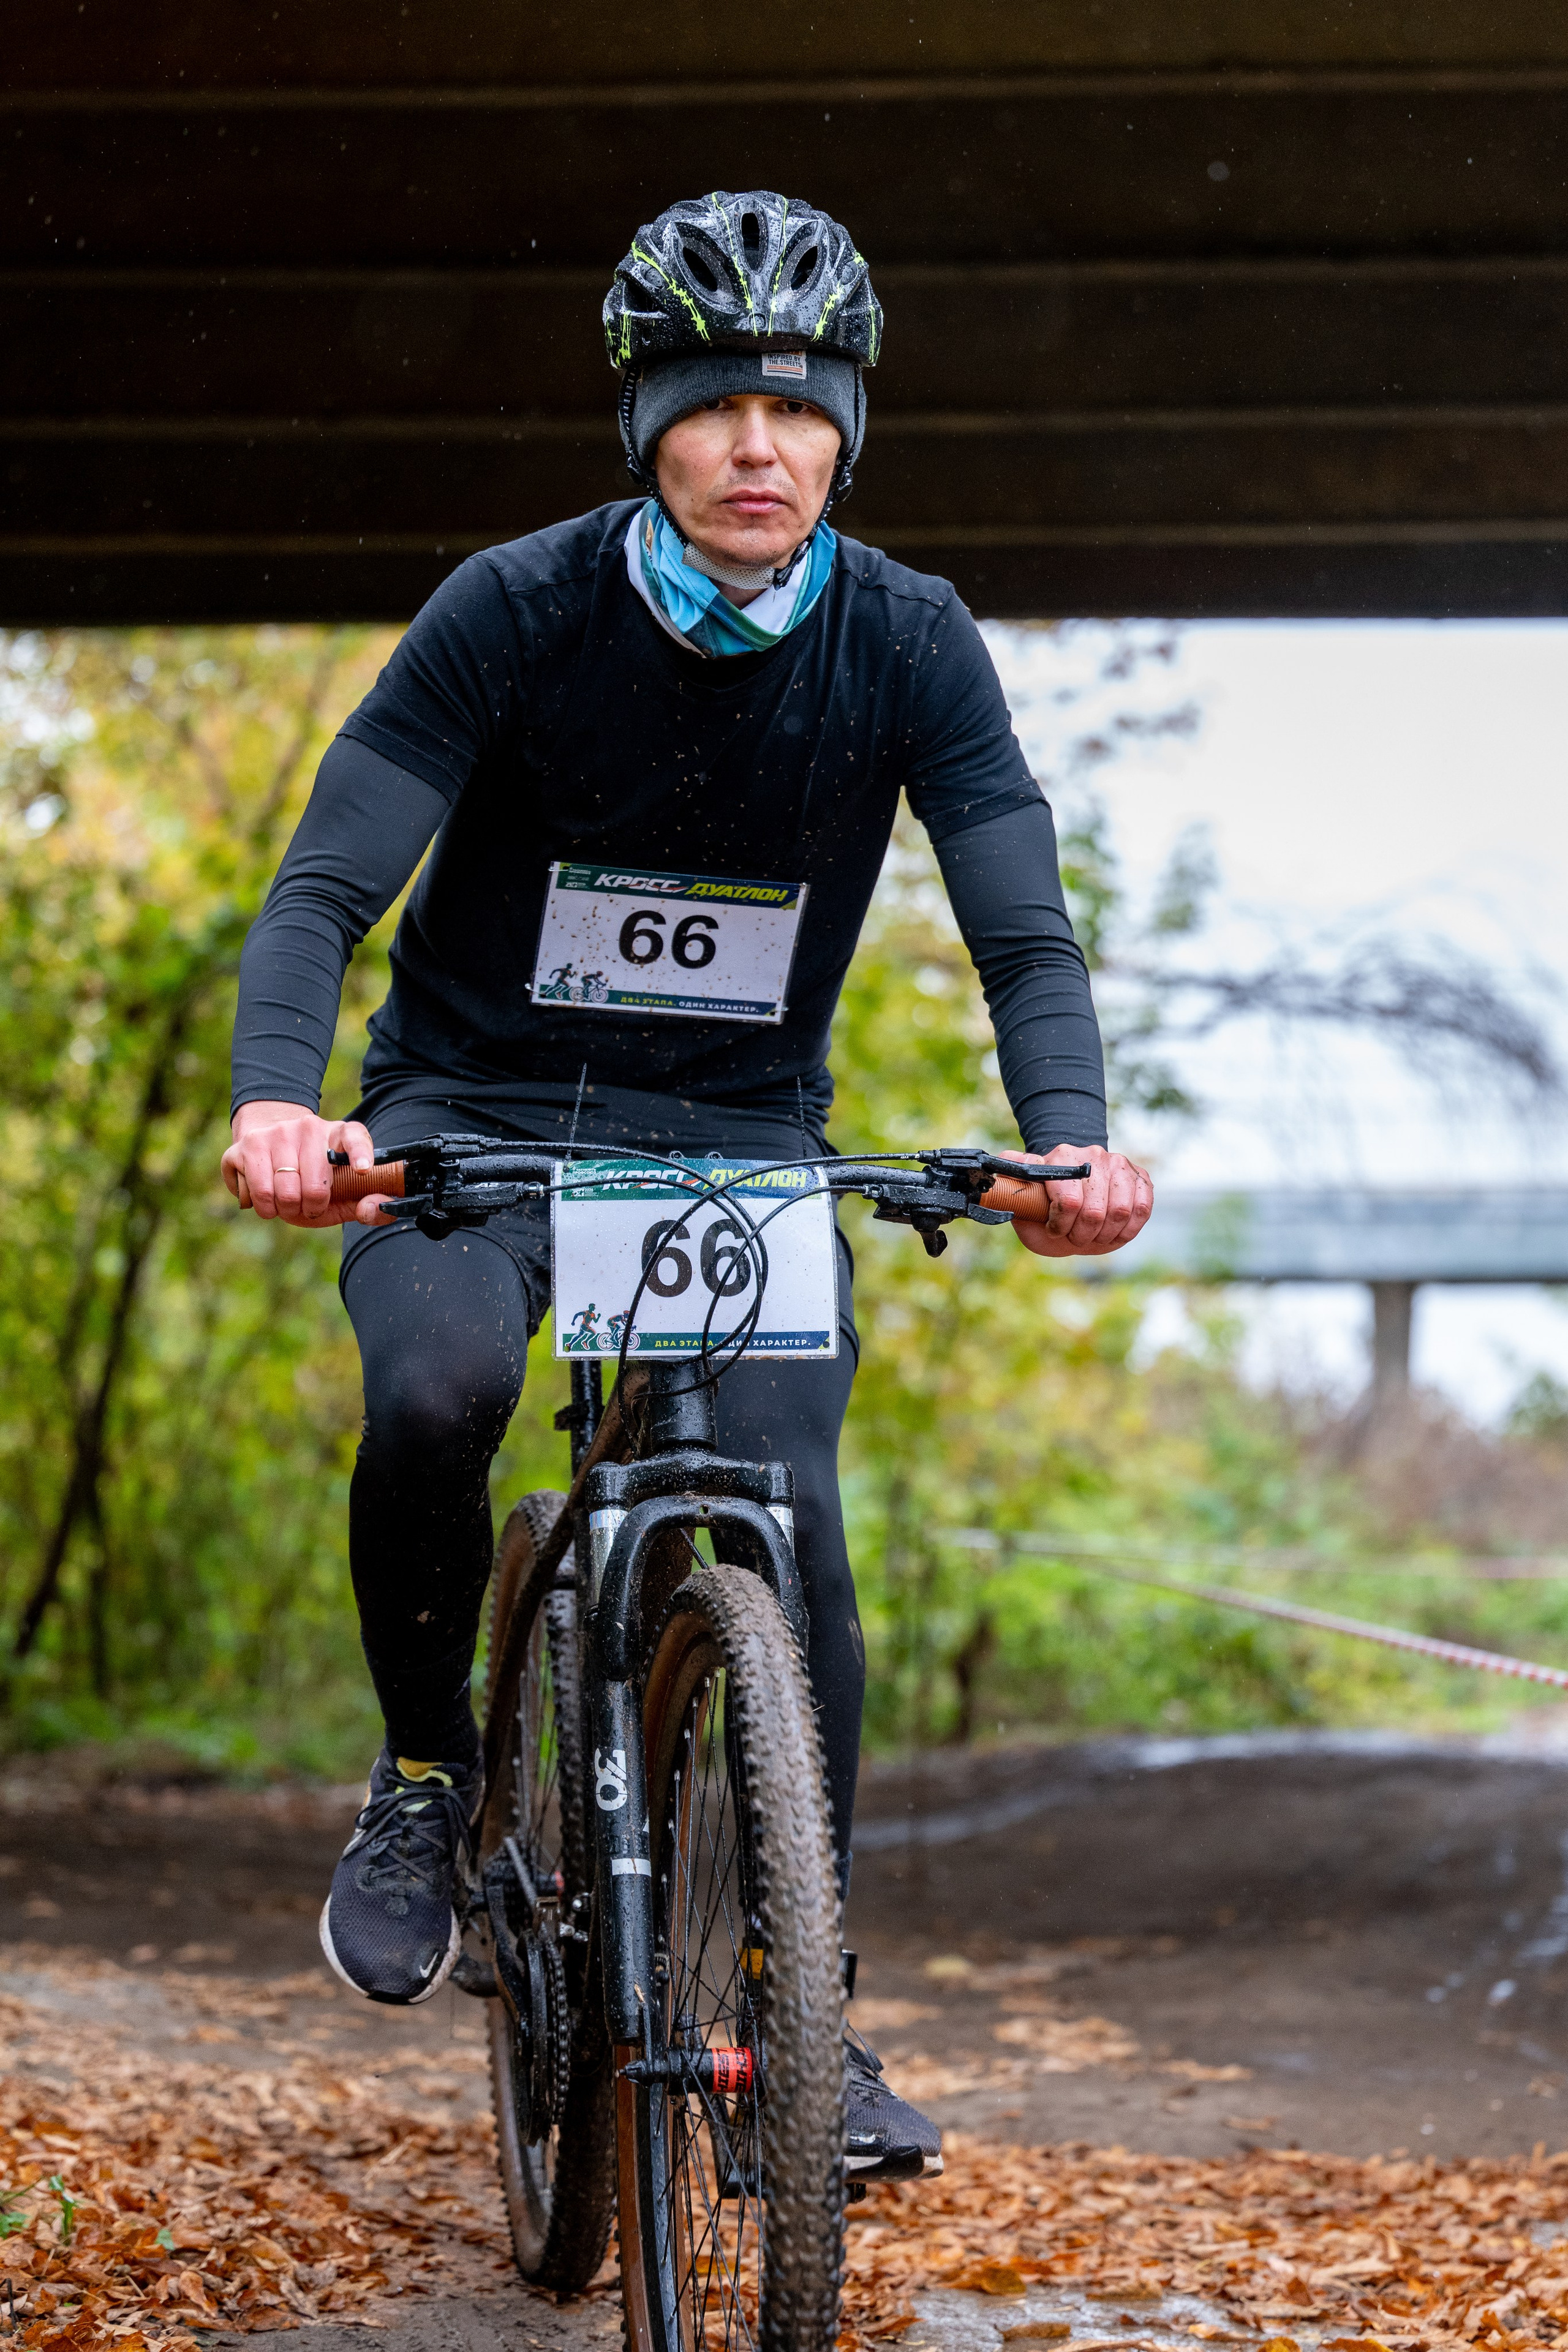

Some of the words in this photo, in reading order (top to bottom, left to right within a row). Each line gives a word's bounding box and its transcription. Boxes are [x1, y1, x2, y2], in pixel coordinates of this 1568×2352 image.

[594, 873, 689, 893] КРОСС
[684, 883, 788, 902] ДУАТЛОН
[619, 910, 719, 970] 66
[707, 1003, 760, 1013] ХАРАКТЕР.
[641, 1218, 751, 1298] 66
